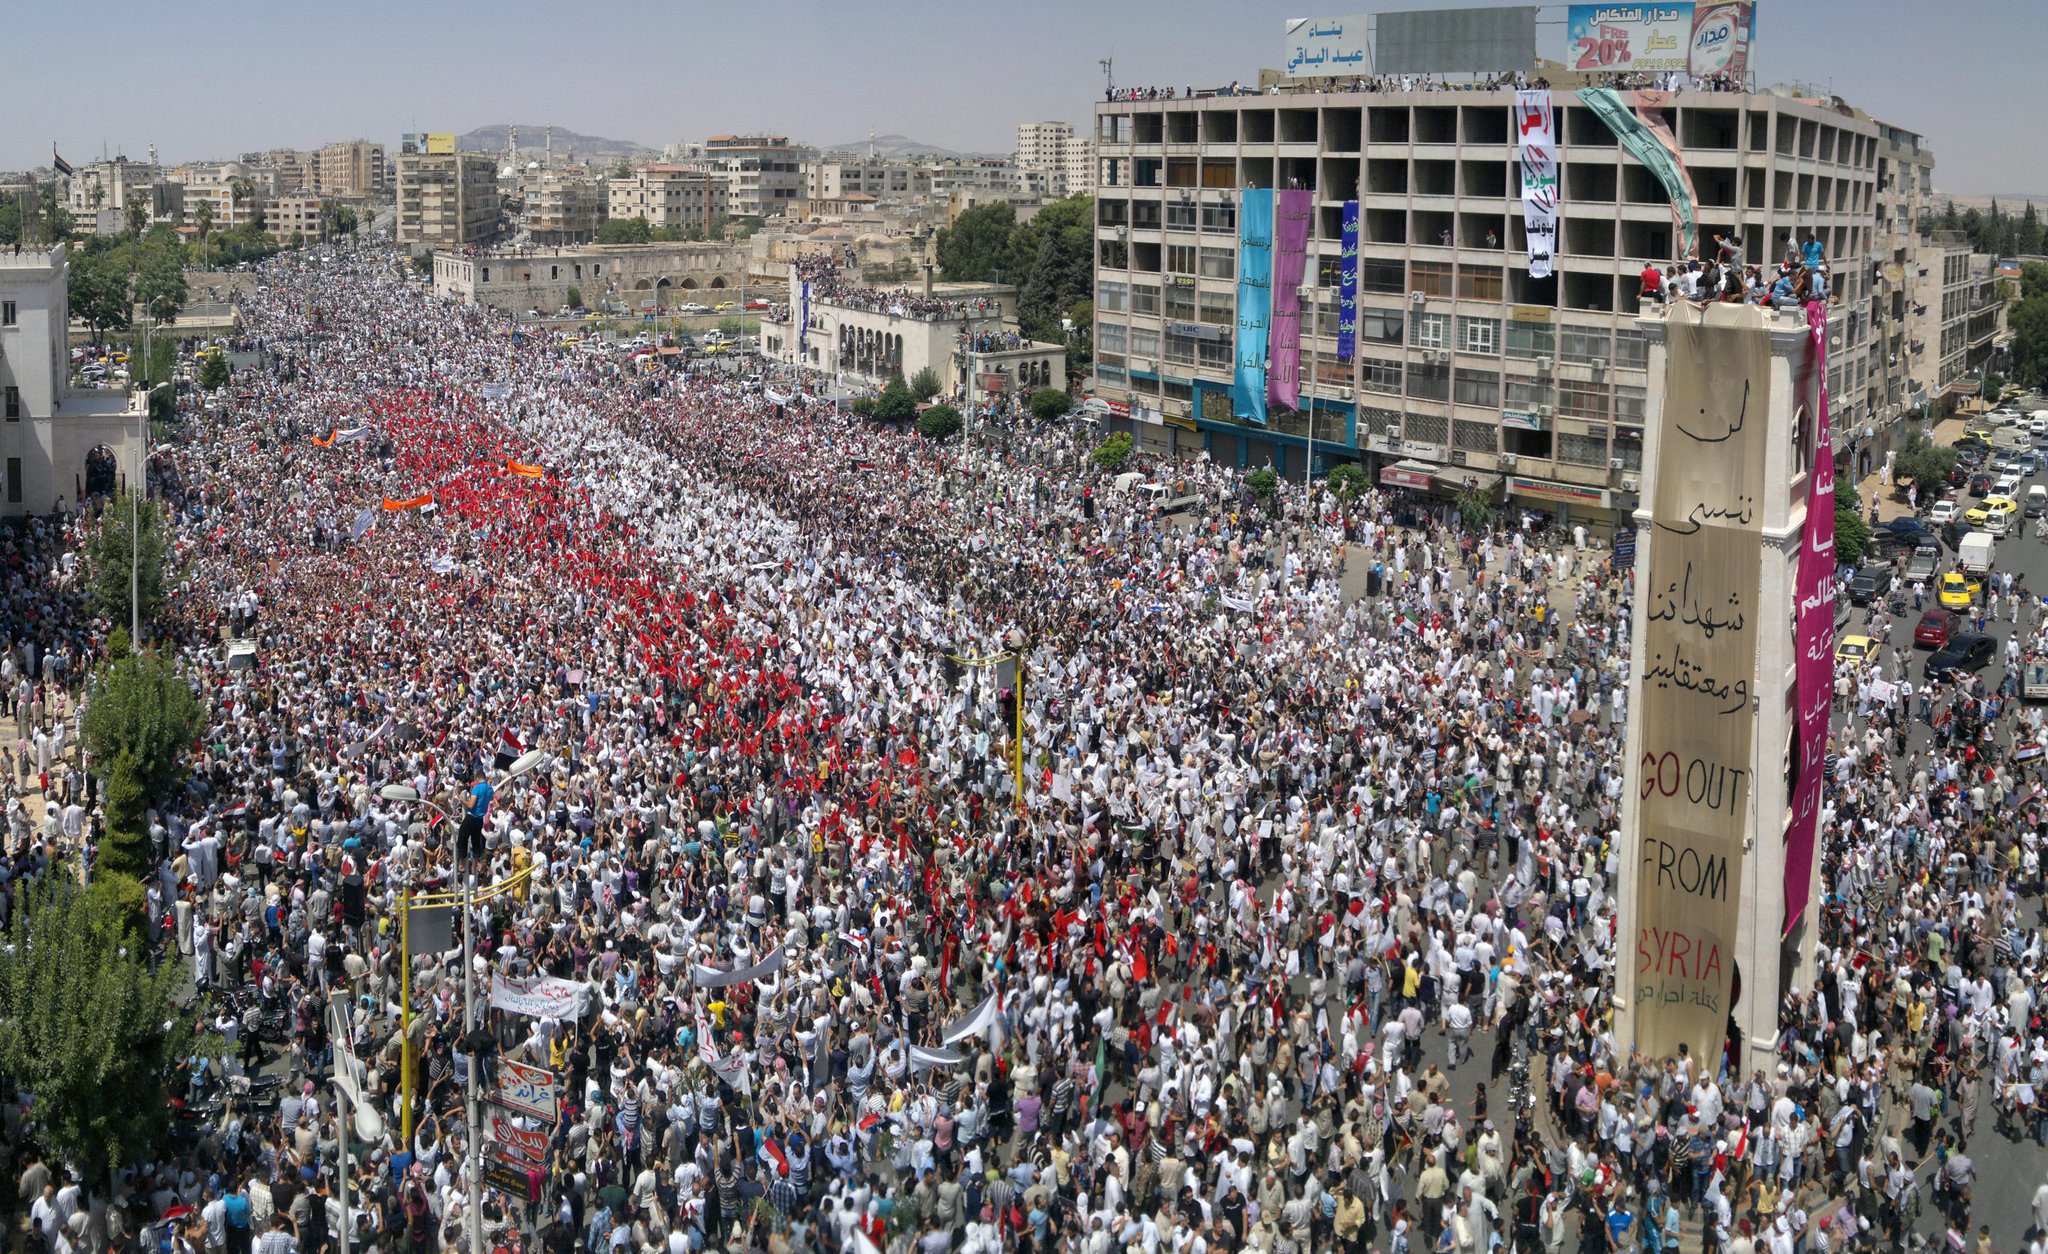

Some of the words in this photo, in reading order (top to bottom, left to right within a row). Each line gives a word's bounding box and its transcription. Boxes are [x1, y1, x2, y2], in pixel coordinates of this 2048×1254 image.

[1309, 20, 1343, 40] بناء
[1589, 7, 1642, 27] المتكامل
[1600, 25, 1629, 39] FREE
[1645, 8, 1679, 25] مدار
[1645, 29, 1678, 54] عطر
[1696, 24, 1729, 48] مدار
[1288, 45, 1329, 74] الباقي
[1332, 47, 1363, 67] عبد
[1575, 36, 1632, 70] 20%
[1519, 95, 1551, 136] ارحل
[1676, 378, 1751, 442] لن
[1653, 495, 1754, 535] ننسى
[1647, 561, 1745, 639] شهدائنا
[1640, 751, 1681, 801] GO
[1686, 758, 1745, 816] OUT
[1643, 838, 1728, 902] FROM
[1639, 926, 1722, 987] SYRIA
